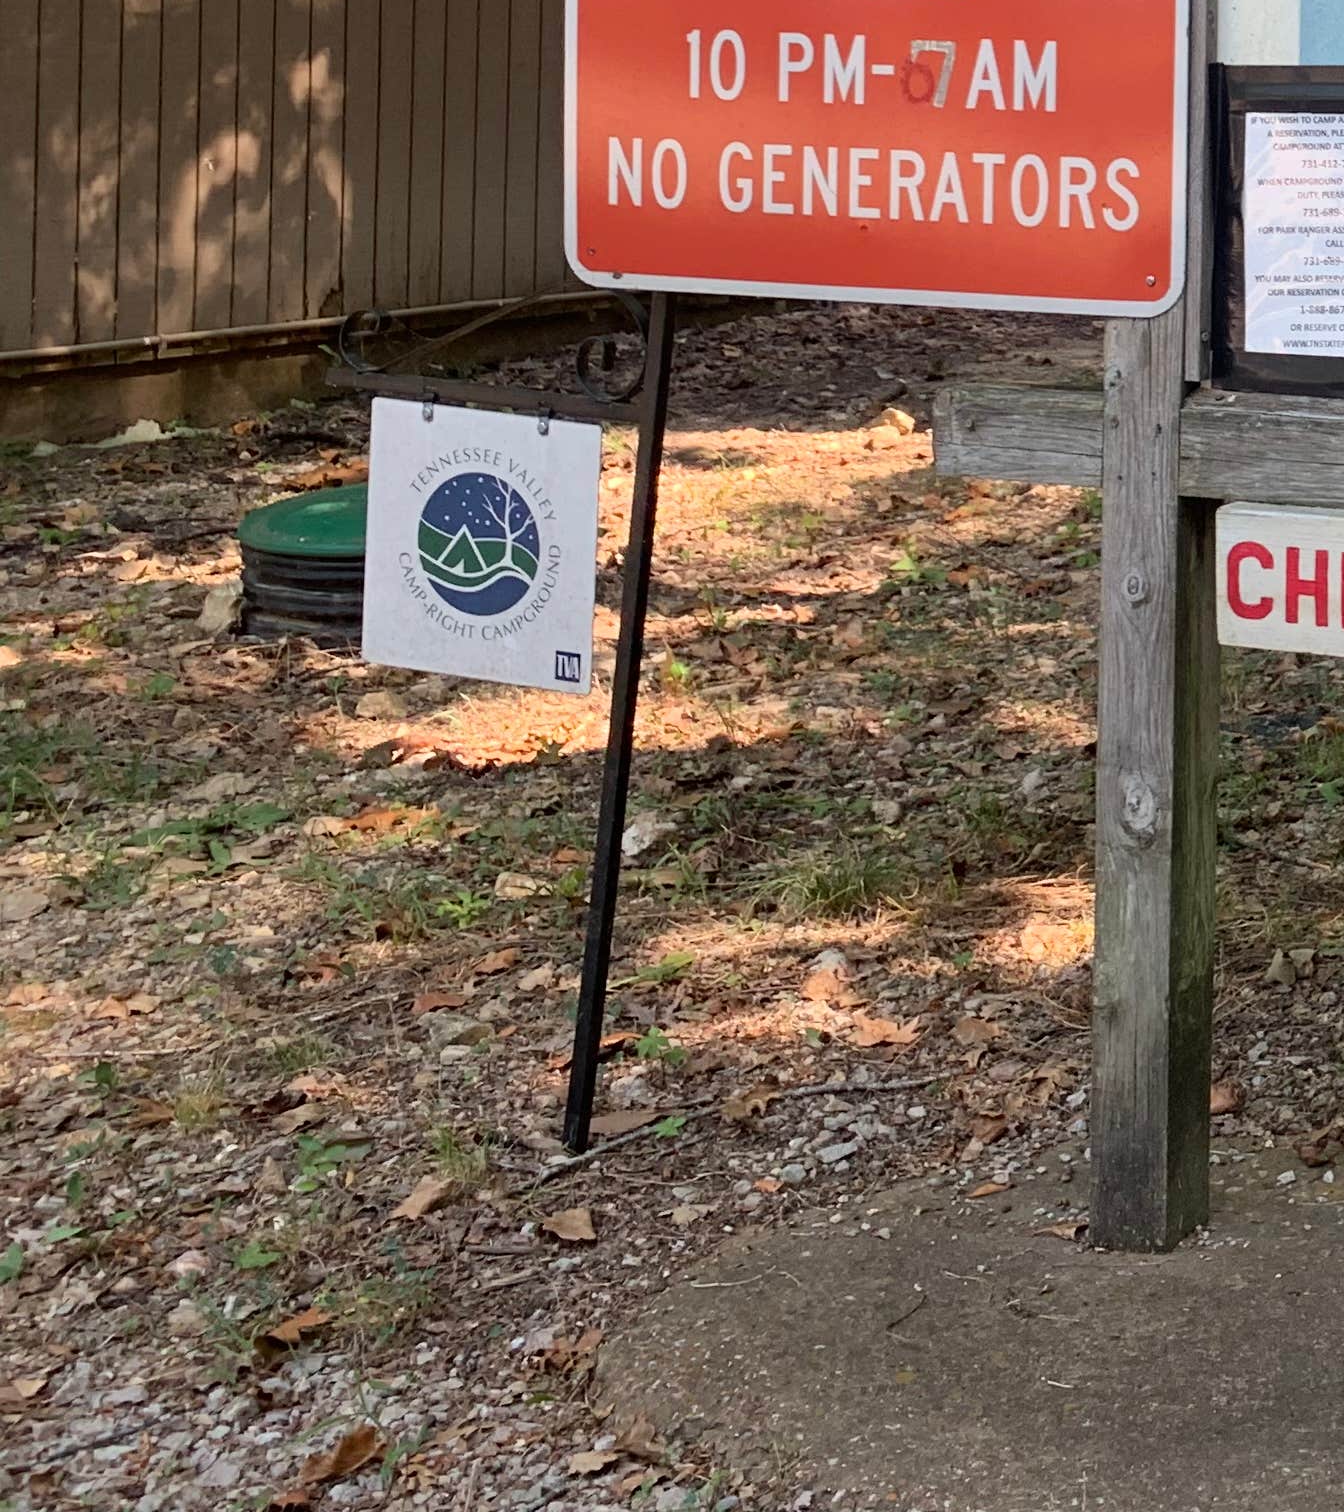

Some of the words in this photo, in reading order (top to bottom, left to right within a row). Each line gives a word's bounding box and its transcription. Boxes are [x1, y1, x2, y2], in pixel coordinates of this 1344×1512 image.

[687, 29, 746, 101] 10
[966, 39, 1057, 113] AM
[608, 136, 688, 209] NO
[718, 141, 1140, 232] GENERATORS
[408, 447, 502, 495] TENNESSEE
[509, 457, 558, 522] VALLEY
[399, 552, 477, 639] CAMP-RIGHT
[480, 544, 562, 640] CAMPGROUND
[557, 652, 580, 680] TVA
